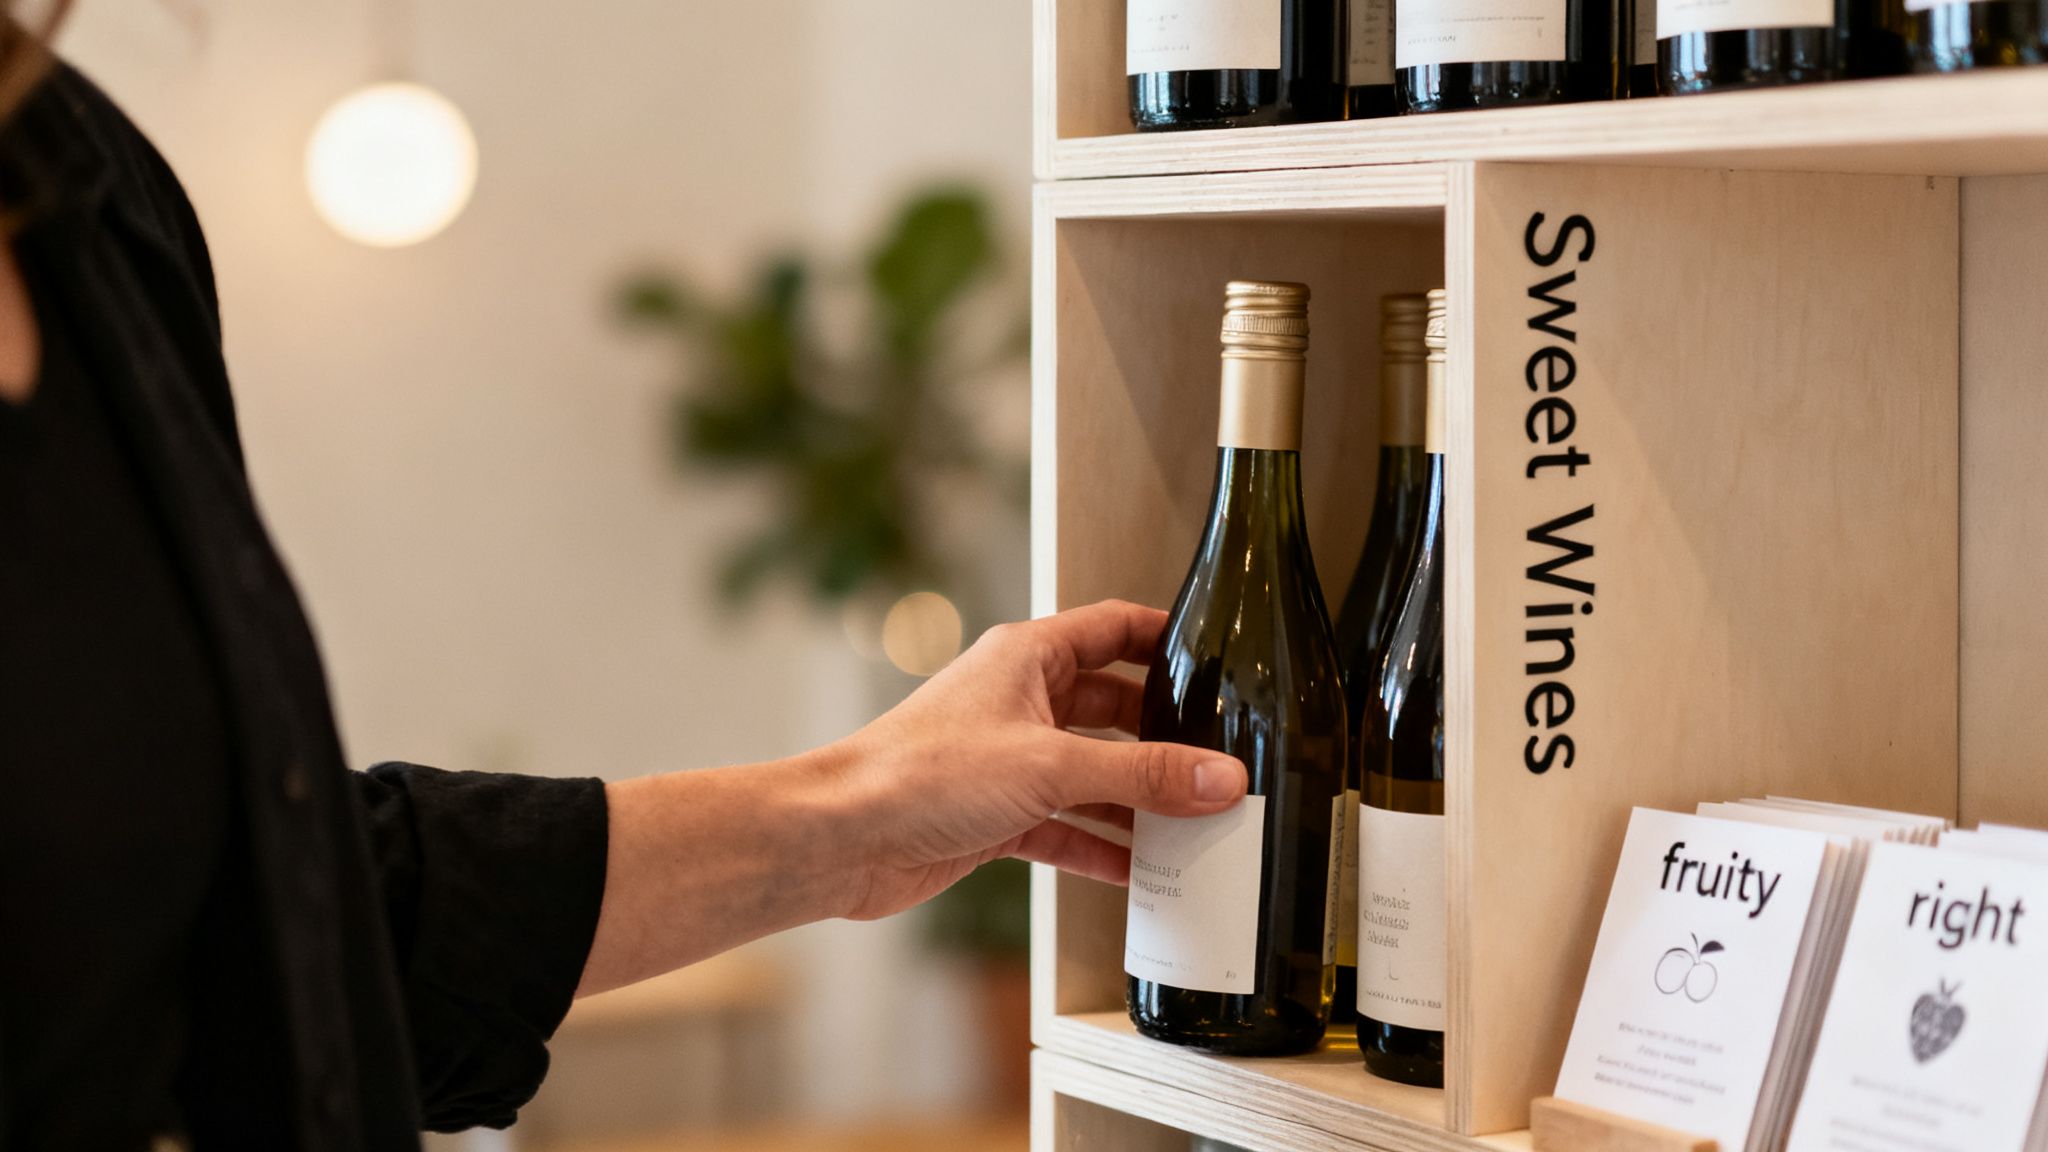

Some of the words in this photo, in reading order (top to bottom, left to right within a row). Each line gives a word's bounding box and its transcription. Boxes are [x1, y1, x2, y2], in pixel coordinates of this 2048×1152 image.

[1523, 211, 1596, 479] Sweet
[1523, 503, 1597, 775] Wines
[1660, 841, 1782, 919] fruity
[1908, 881, 2025, 950] right
